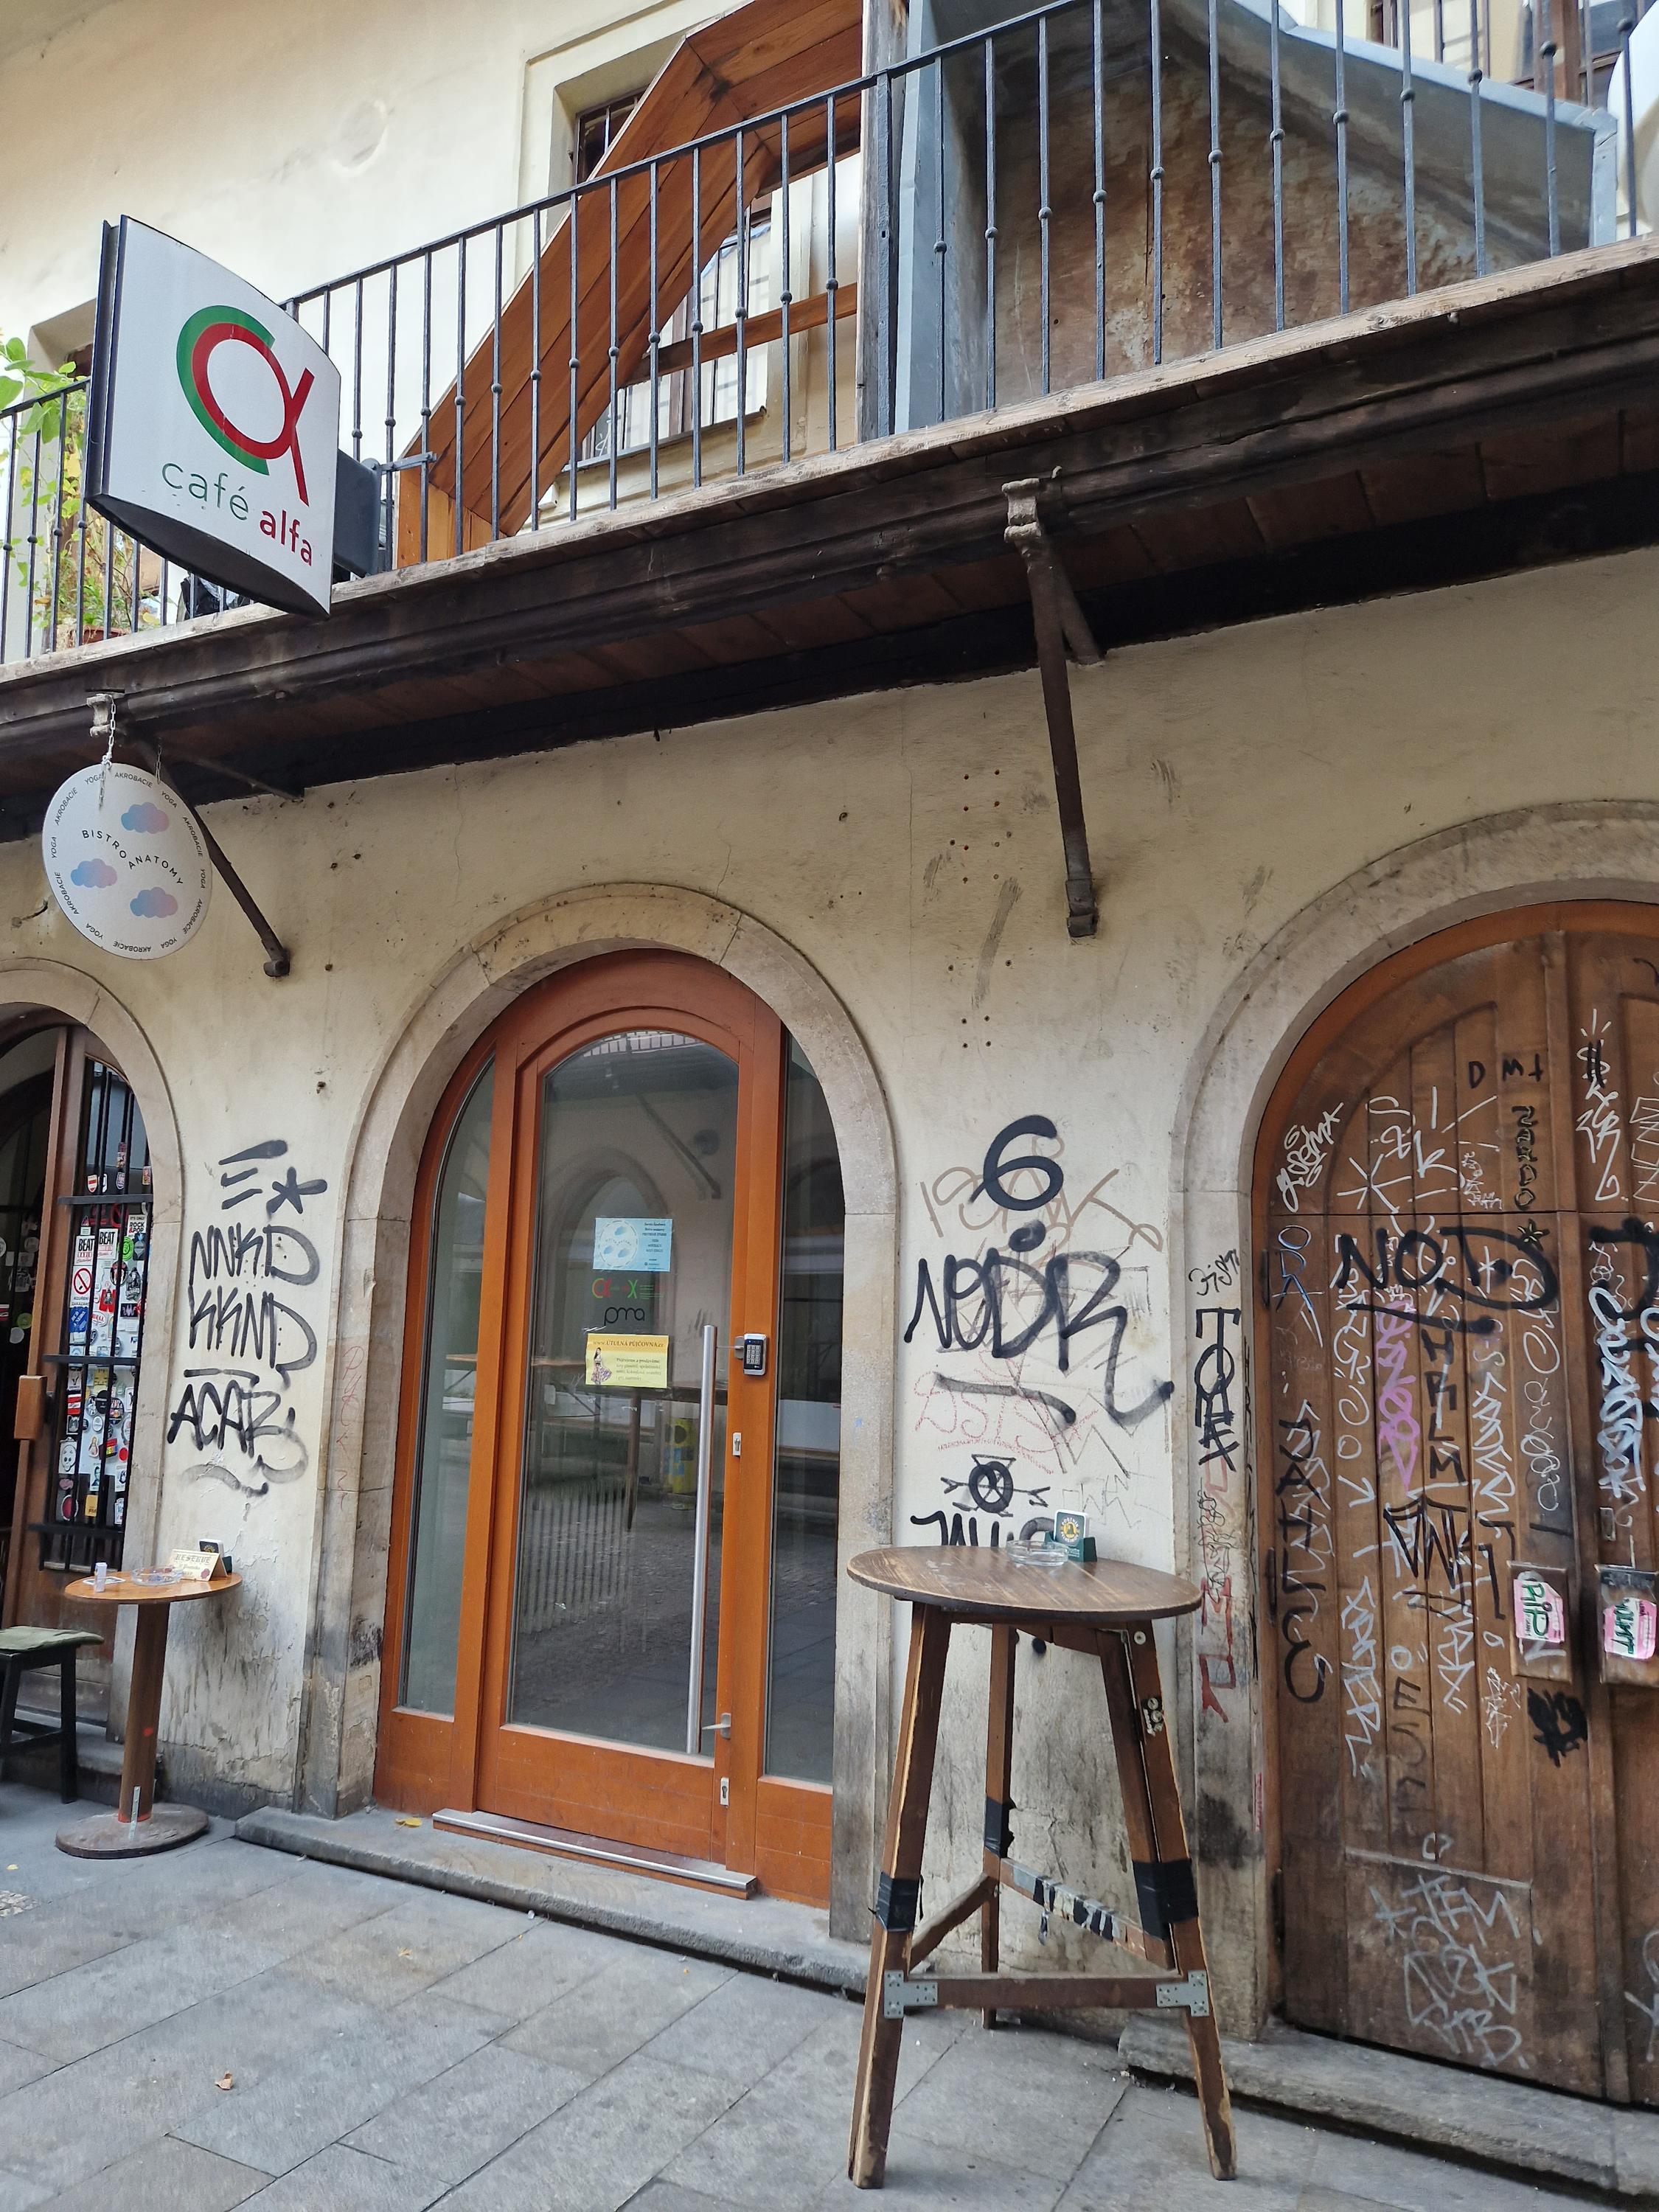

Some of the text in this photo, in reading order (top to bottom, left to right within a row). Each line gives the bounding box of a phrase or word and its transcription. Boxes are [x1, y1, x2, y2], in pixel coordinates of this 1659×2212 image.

[161, 462, 313, 567] café alfa
[85, 773, 105, 785] YOGA
[114, 772, 153, 788] AKROBACIE
[55, 787, 78, 826] AKROBACIE
[161, 790, 178, 808] YOGA
[183, 816, 203, 857] AKROBACIE
[82, 830, 183, 885] BISTRO ANATOMY
[56, 872, 80, 914] AKROBACIE
[183, 899, 202, 934] AKROBACIE
[86, 923, 103, 939] YOGA
[113, 940, 151, 953] AKROBACIE
[161, 937, 178, 949] YOGA
[78, 1238, 94, 1251] BEAT
[99, 1231, 116, 1245] BEAT
